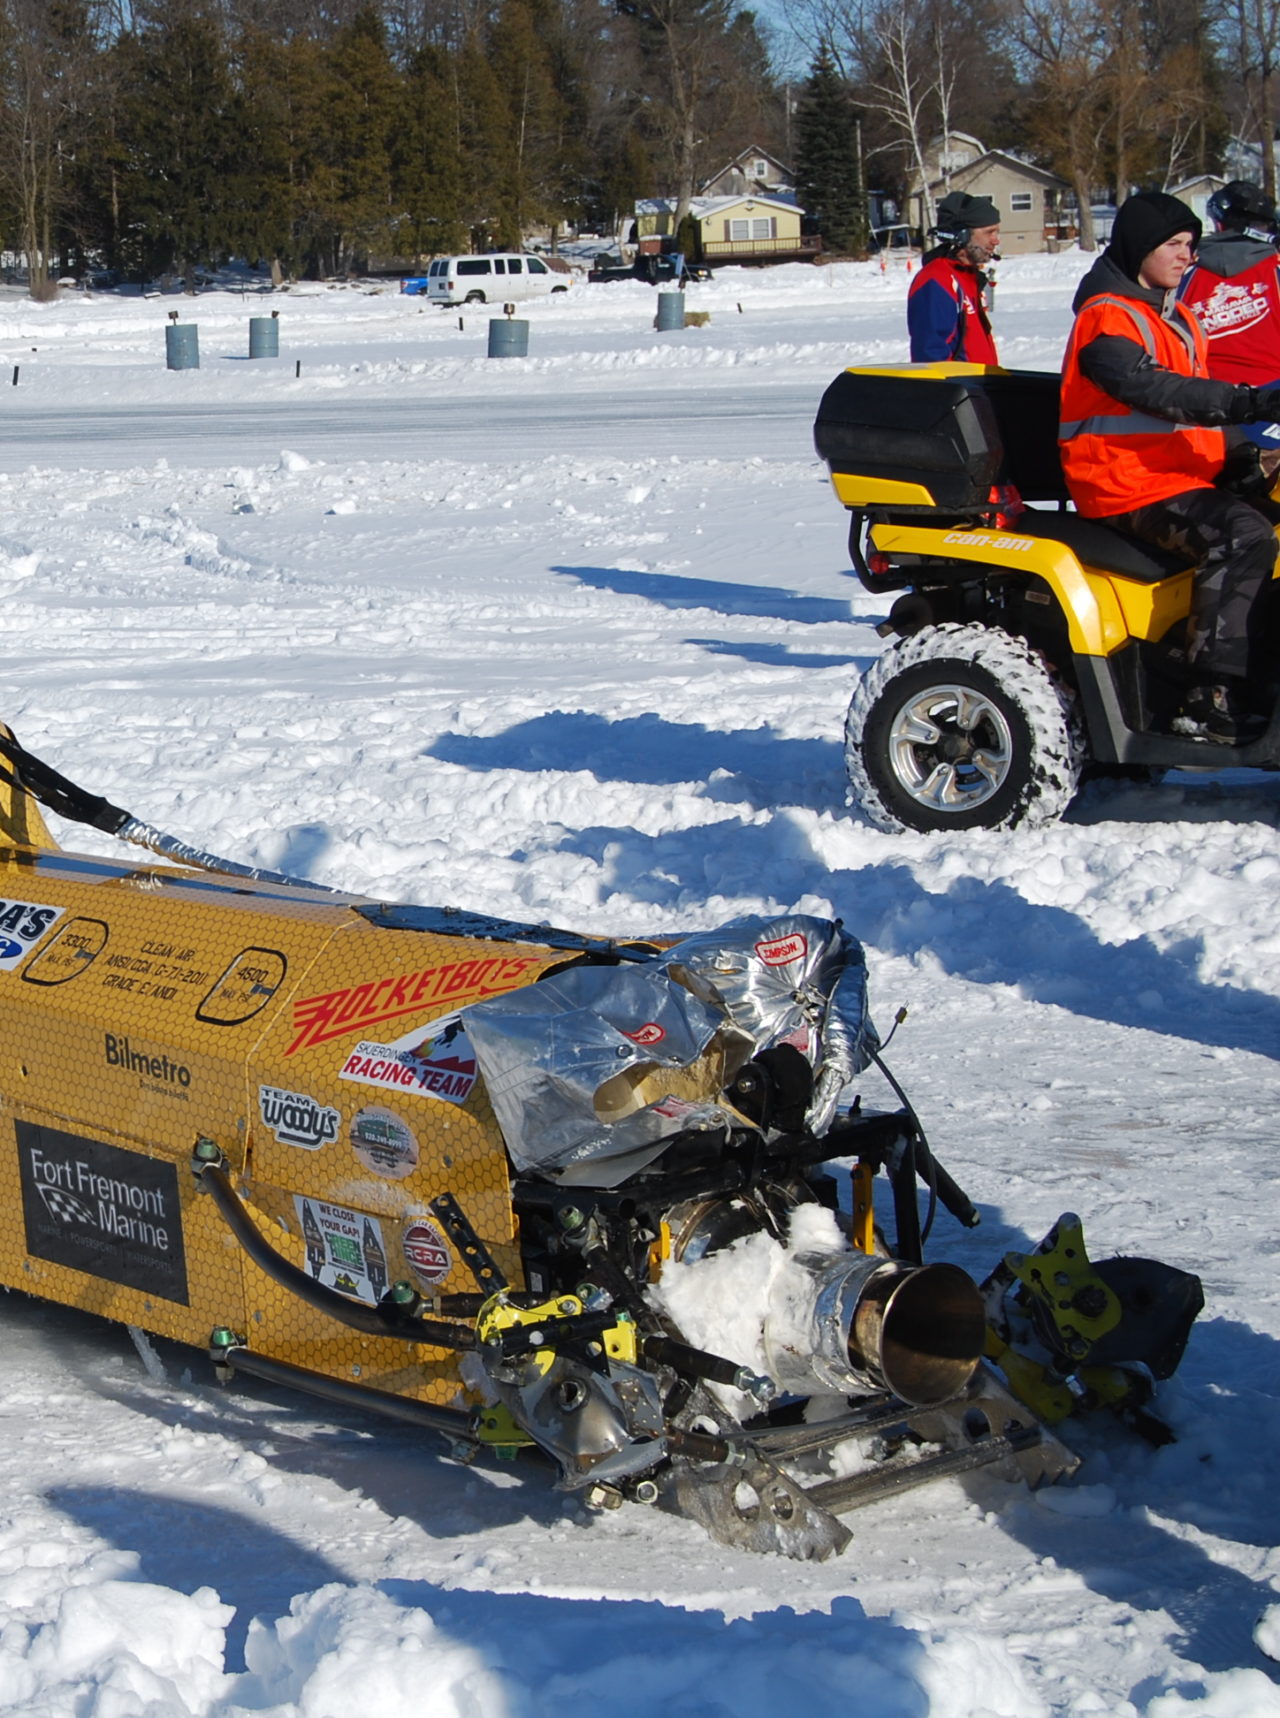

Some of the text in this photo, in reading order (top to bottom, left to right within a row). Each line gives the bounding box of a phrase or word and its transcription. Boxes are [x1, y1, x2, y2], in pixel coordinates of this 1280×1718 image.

[1200, 296, 1268, 330] NODEO
[141, 941, 196, 962] CLEAN AIR
[237, 966, 269, 984] 4500
[105, 1032, 192, 1088] Bilmetro
[343, 1055, 474, 1098] RACING TEAM
[261, 1088, 311, 1107] TEAM
[30, 1147, 166, 1218] Fort Fremont
[318, 1203, 356, 1223] WE CLOSE
[97, 1199, 169, 1251] Marine
[320, 1218, 341, 1233] YOUR
[405, 1246, 447, 1265] RCRA
